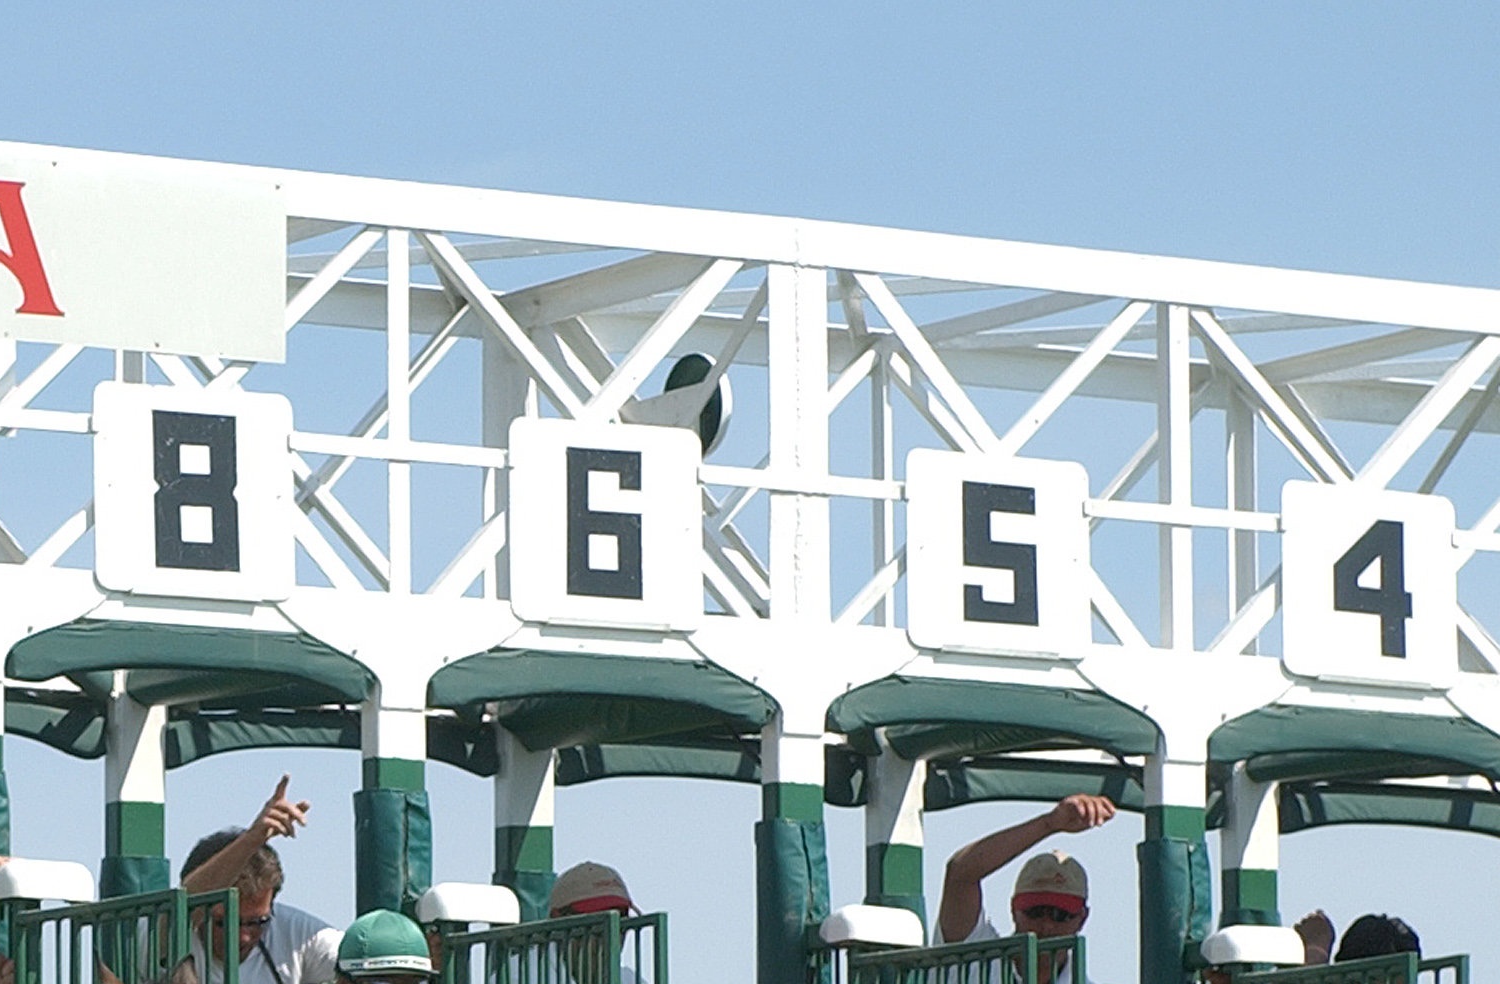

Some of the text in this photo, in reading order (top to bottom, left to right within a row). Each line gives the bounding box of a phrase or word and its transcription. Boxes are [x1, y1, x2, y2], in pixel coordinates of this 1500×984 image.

[152, 409, 240, 572] 8
[566, 447, 643, 600] 6
[962, 481, 1039, 627] 5
[1333, 519, 1413, 658] 4
